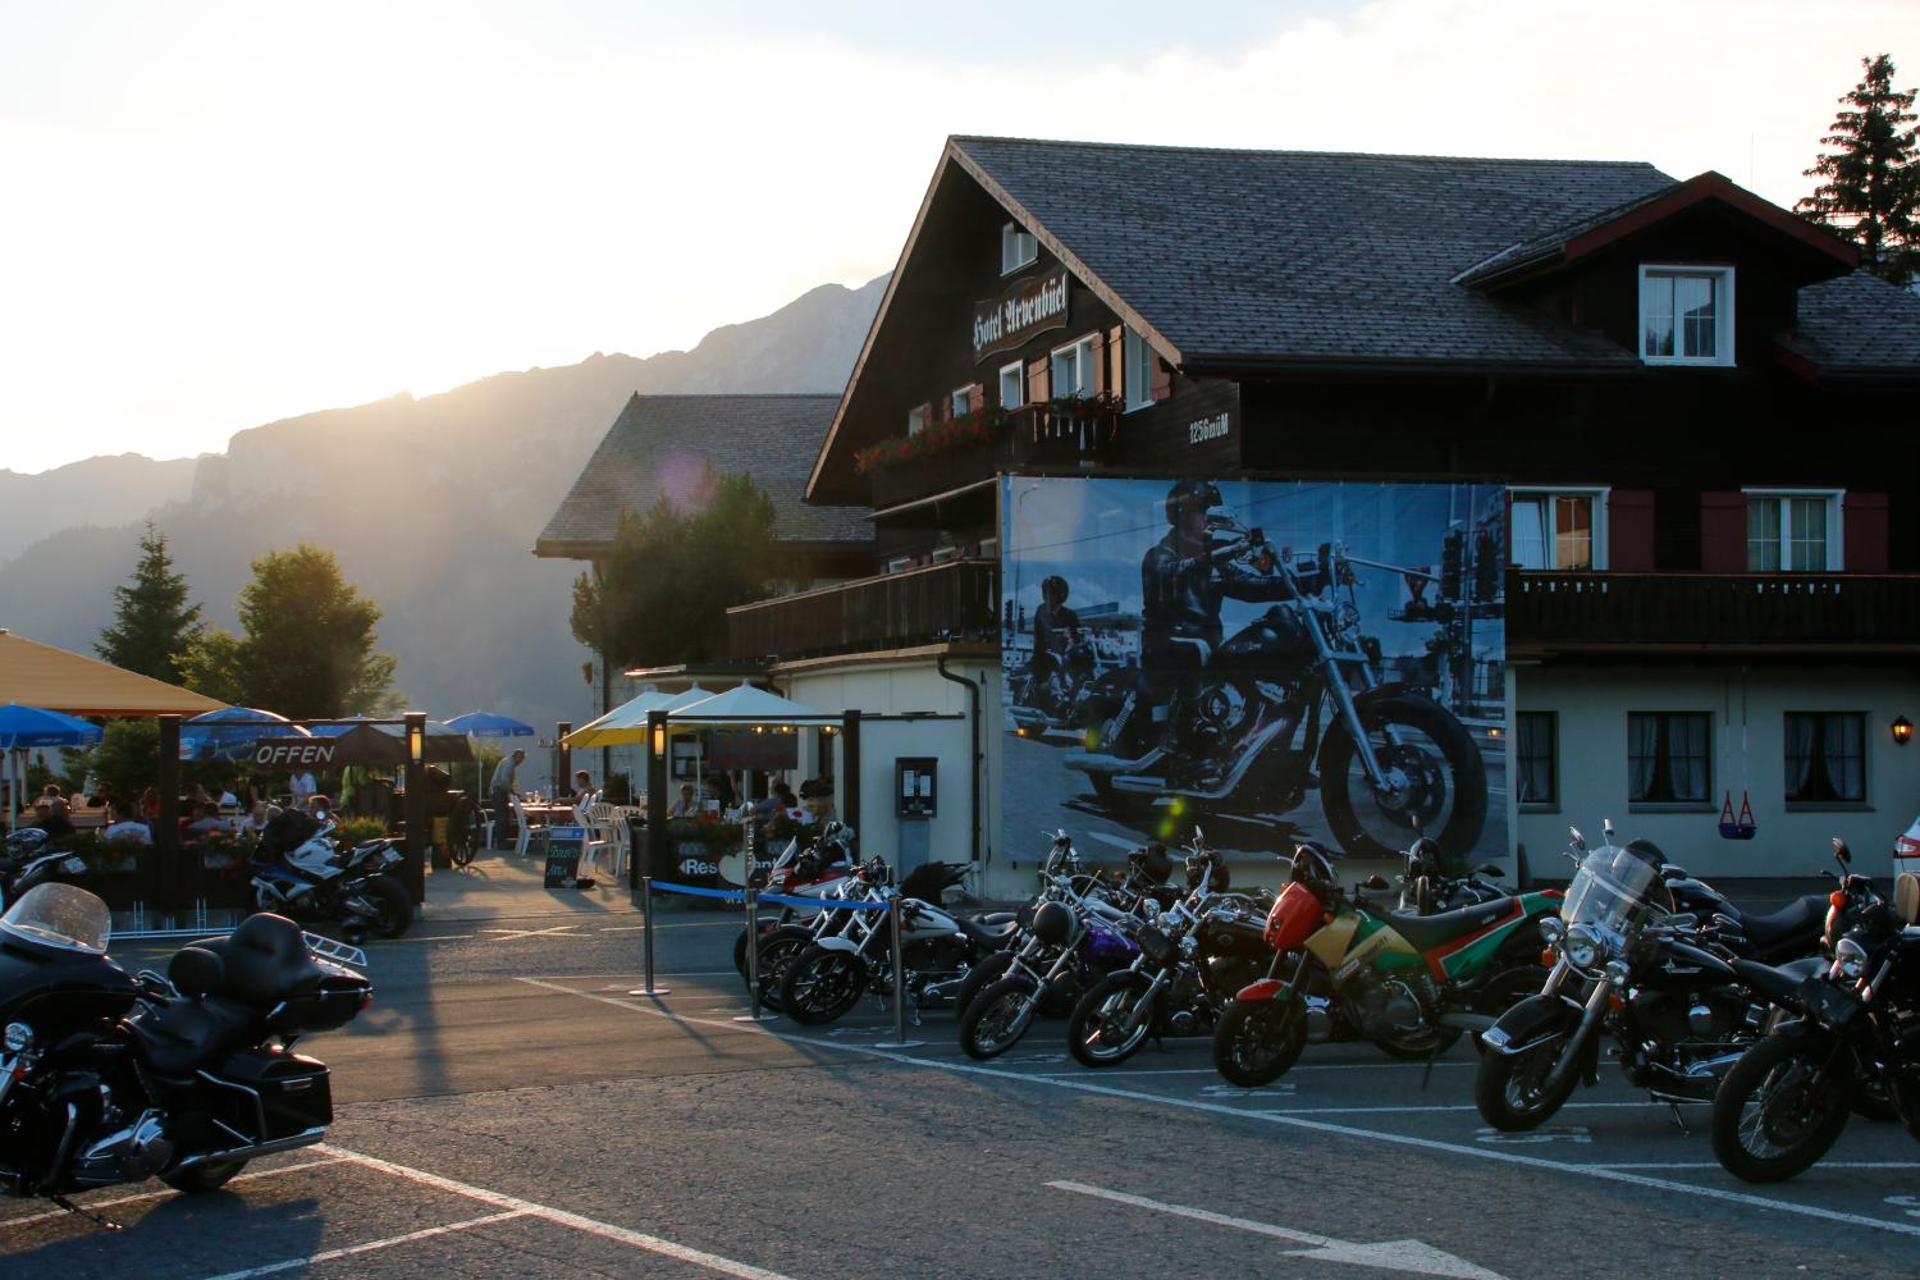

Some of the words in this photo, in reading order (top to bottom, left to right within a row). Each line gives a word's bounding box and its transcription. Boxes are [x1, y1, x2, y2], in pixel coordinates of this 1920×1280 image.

[973, 304, 1002, 351] Hotel
[1005, 272, 1067, 334] Arvenbüel
[256, 745, 336, 764] OFFEN
